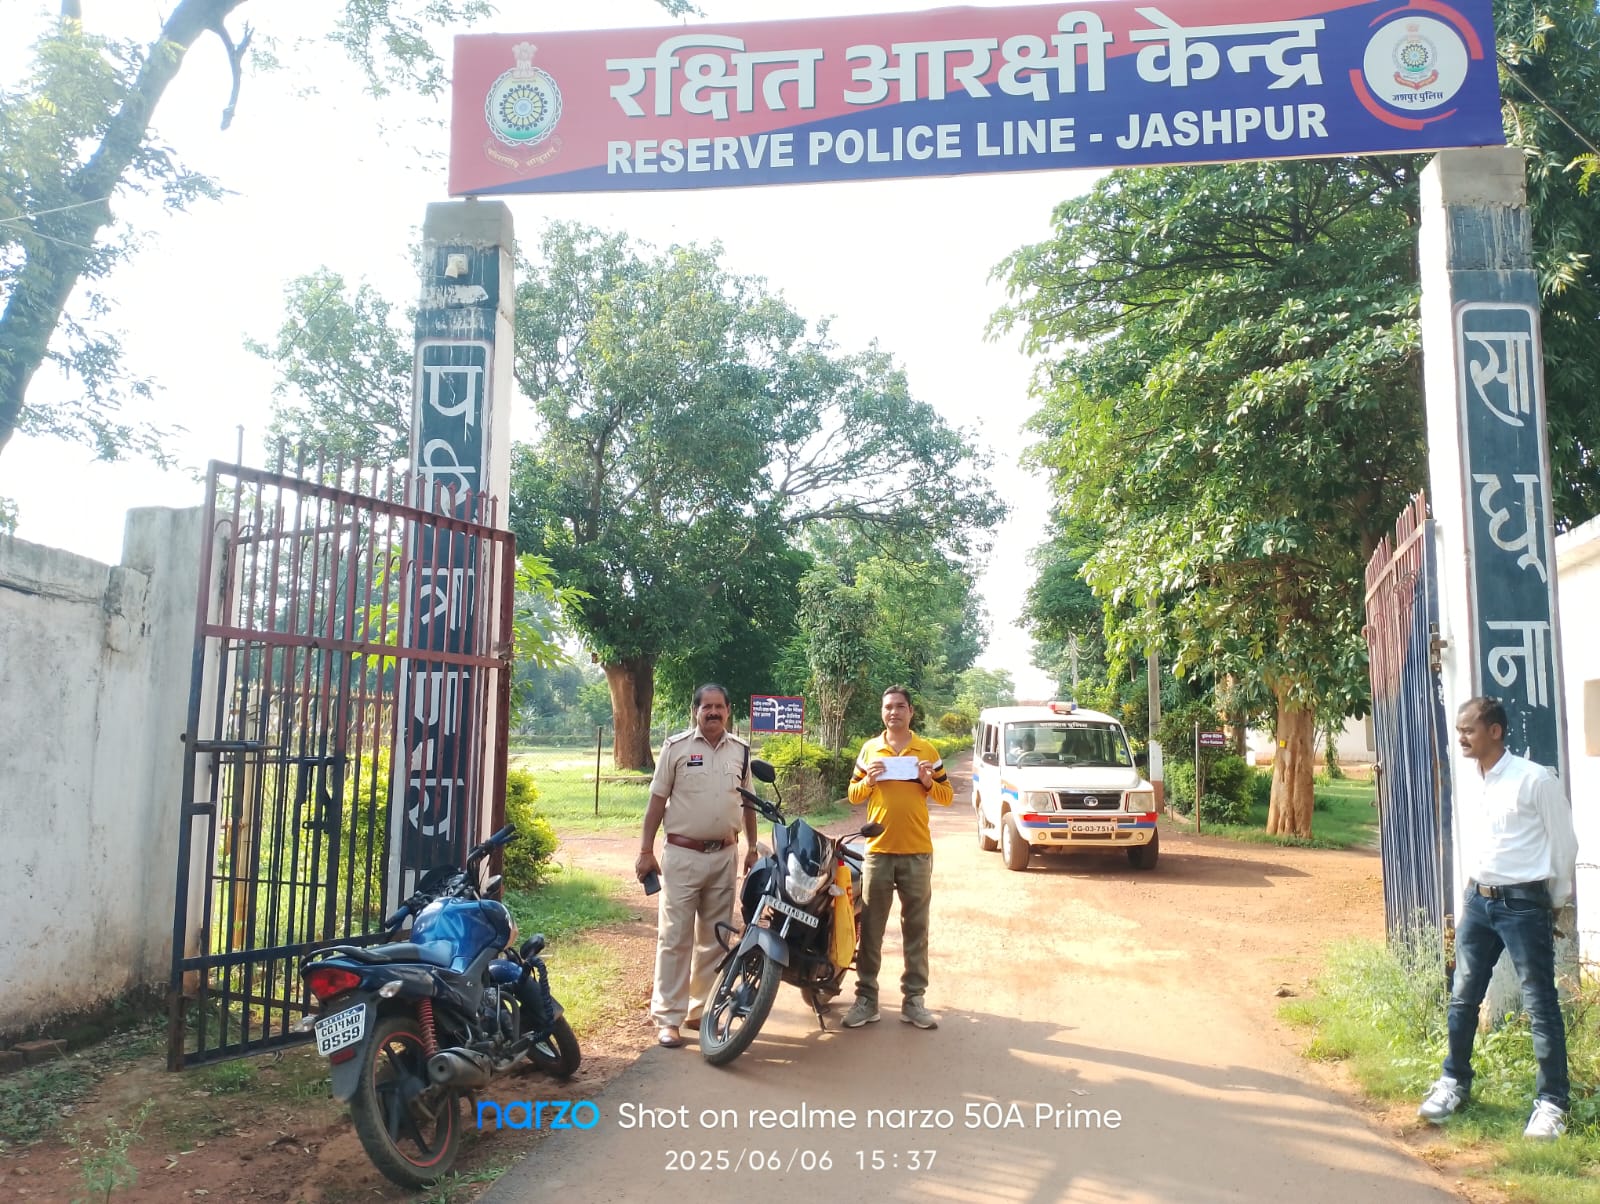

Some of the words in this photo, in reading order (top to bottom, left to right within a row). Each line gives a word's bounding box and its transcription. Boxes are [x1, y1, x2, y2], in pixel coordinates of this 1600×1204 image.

[605, 34, 824, 120] रक्षित
[843, 10, 1114, 105] आरक्षी
[1129, 7, 1325, 90] केन्द्र
[1419, 90, 1443, 102] पुलिस
[607, 132, 794, 174] RESERVE
[809, 123, 962, 166] POLICE
[977, 117, 1076, 157] LINE
[1116, 103, 1329, 149] JASHPUR
[322, 1026, 360, 1051] 8559
